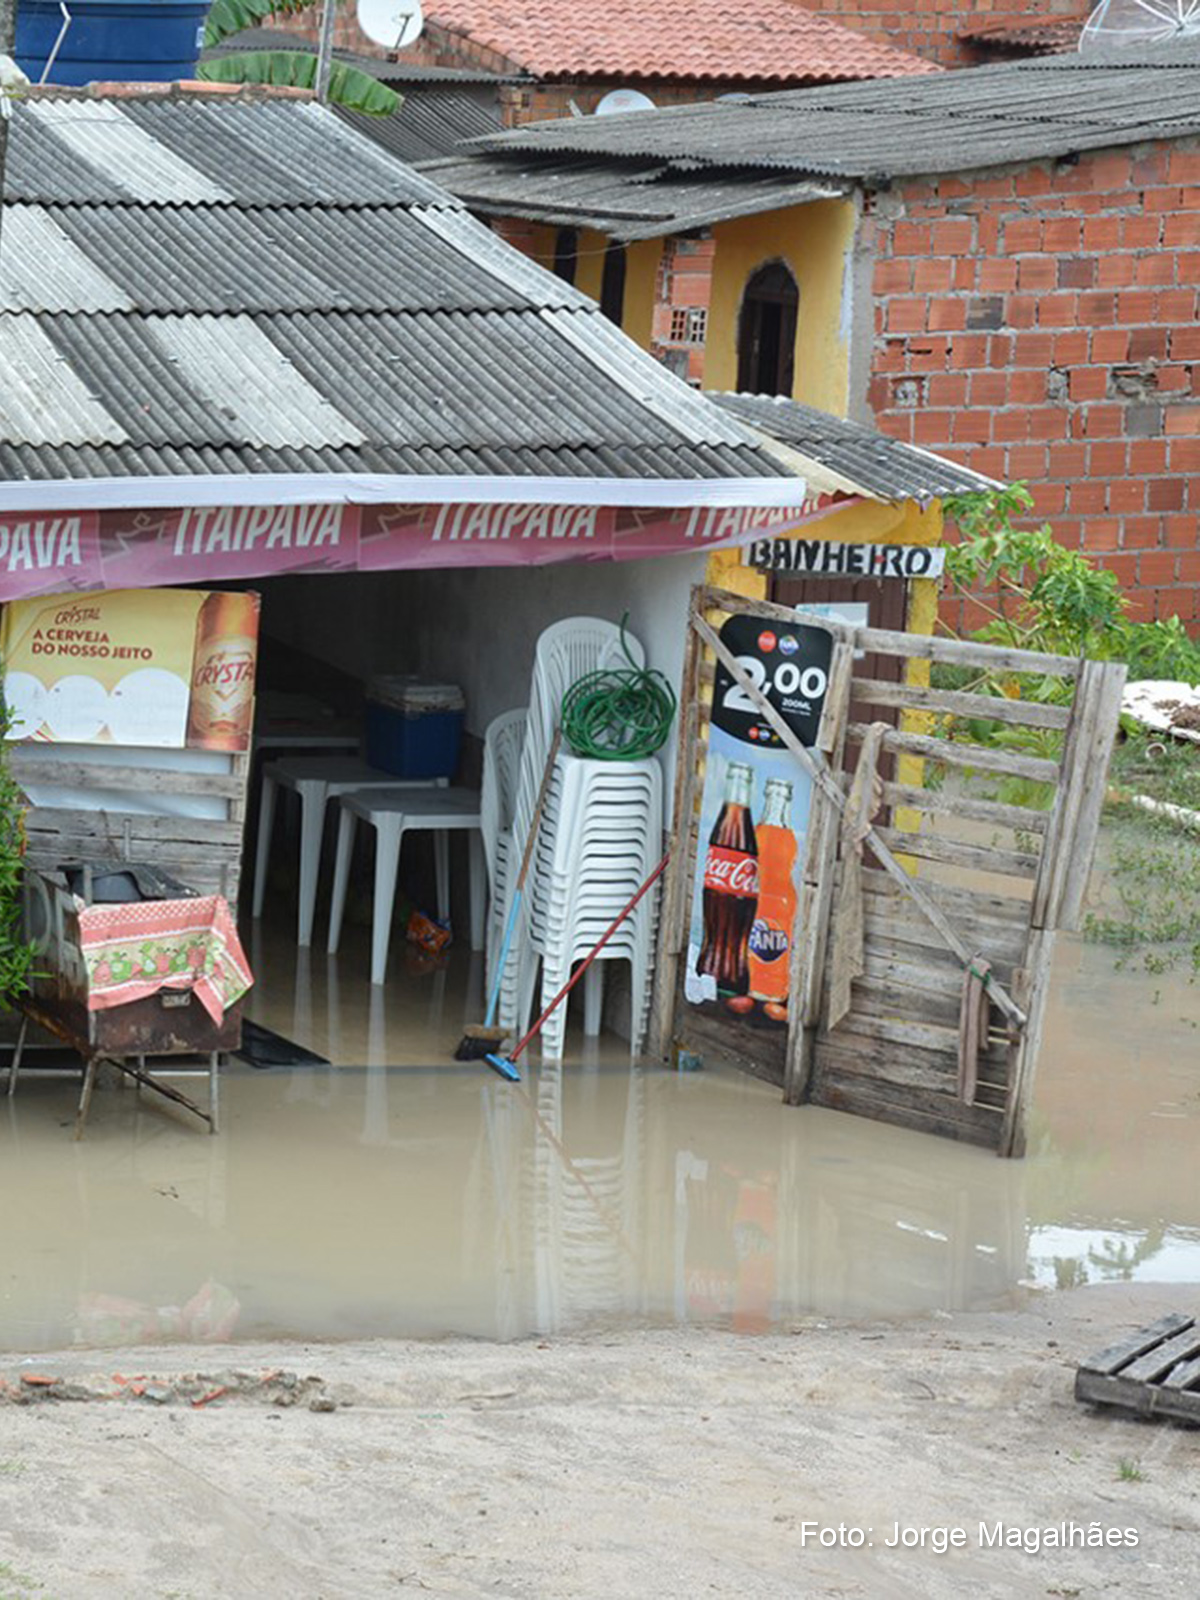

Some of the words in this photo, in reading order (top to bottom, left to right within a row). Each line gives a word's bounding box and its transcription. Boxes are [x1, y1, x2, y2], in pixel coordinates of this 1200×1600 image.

[173, 504, 343, 555] ITAIPAVA
[431, 504, 597, 541] ITAIPAVA
[750, 539, 932, 577] BANHEIRO
[54, 605, 101, 625] CRYSTAL
[31, 642, 56, 655] DO
[58, 644, 110, 658] NOSSO
[111, 647, 153, 660] JEITO
[33, 629, 44, 640] A
[46, 629, 110, 643] CERVEJA
[722, 655, 827, 714] 2,00
